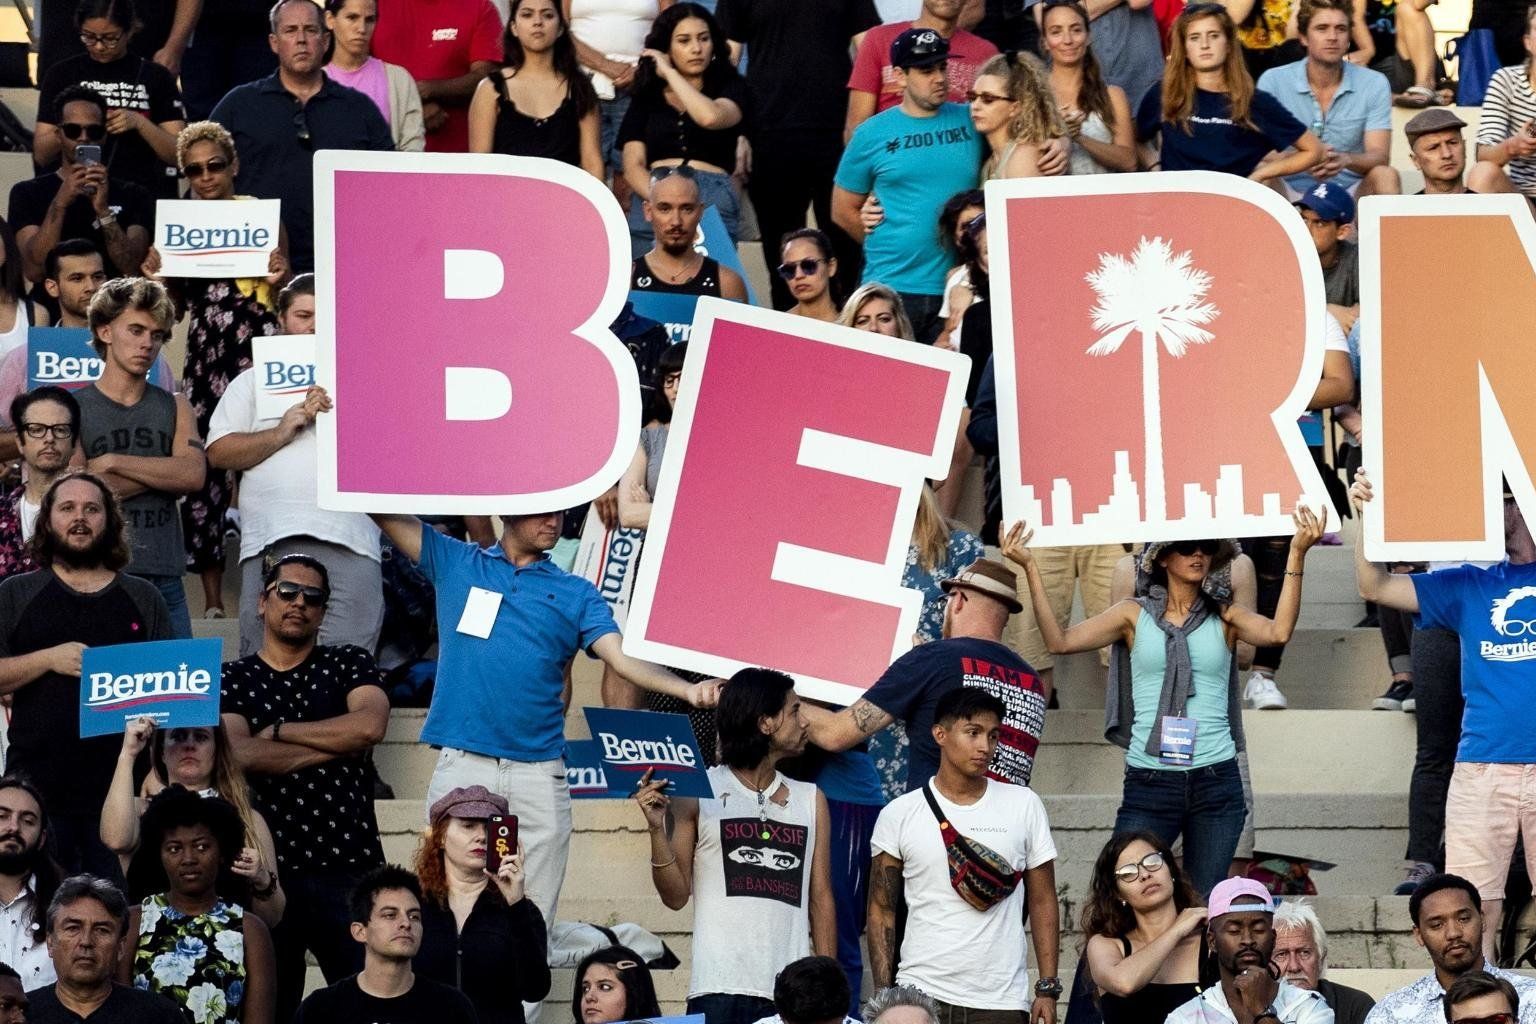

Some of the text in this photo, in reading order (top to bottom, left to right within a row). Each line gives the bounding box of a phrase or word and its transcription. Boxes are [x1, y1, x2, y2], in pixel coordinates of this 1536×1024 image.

[903, 126, 973, 150] ZOO YORK
[163, 222, 270, 249] Bernie
[264, 360, 316, 388] Ber
[600, 526, 641, 614] erni
[88, 662, 211, 703] Bernie
[963, 674, 995, 685] CLIMATE
[995, 680, 1022, 693] CHANGE
[963, 680, 1001, 691] MINIMUM
[1001, 688, 1024, 700] WAGE
[1001, 717, 1041, 739] EMBRACIN
[598, 732, 697, 768] Bernie
[565, 766, 608, 788] rni
[724, 822, 805, 846] SIOUXSIE
